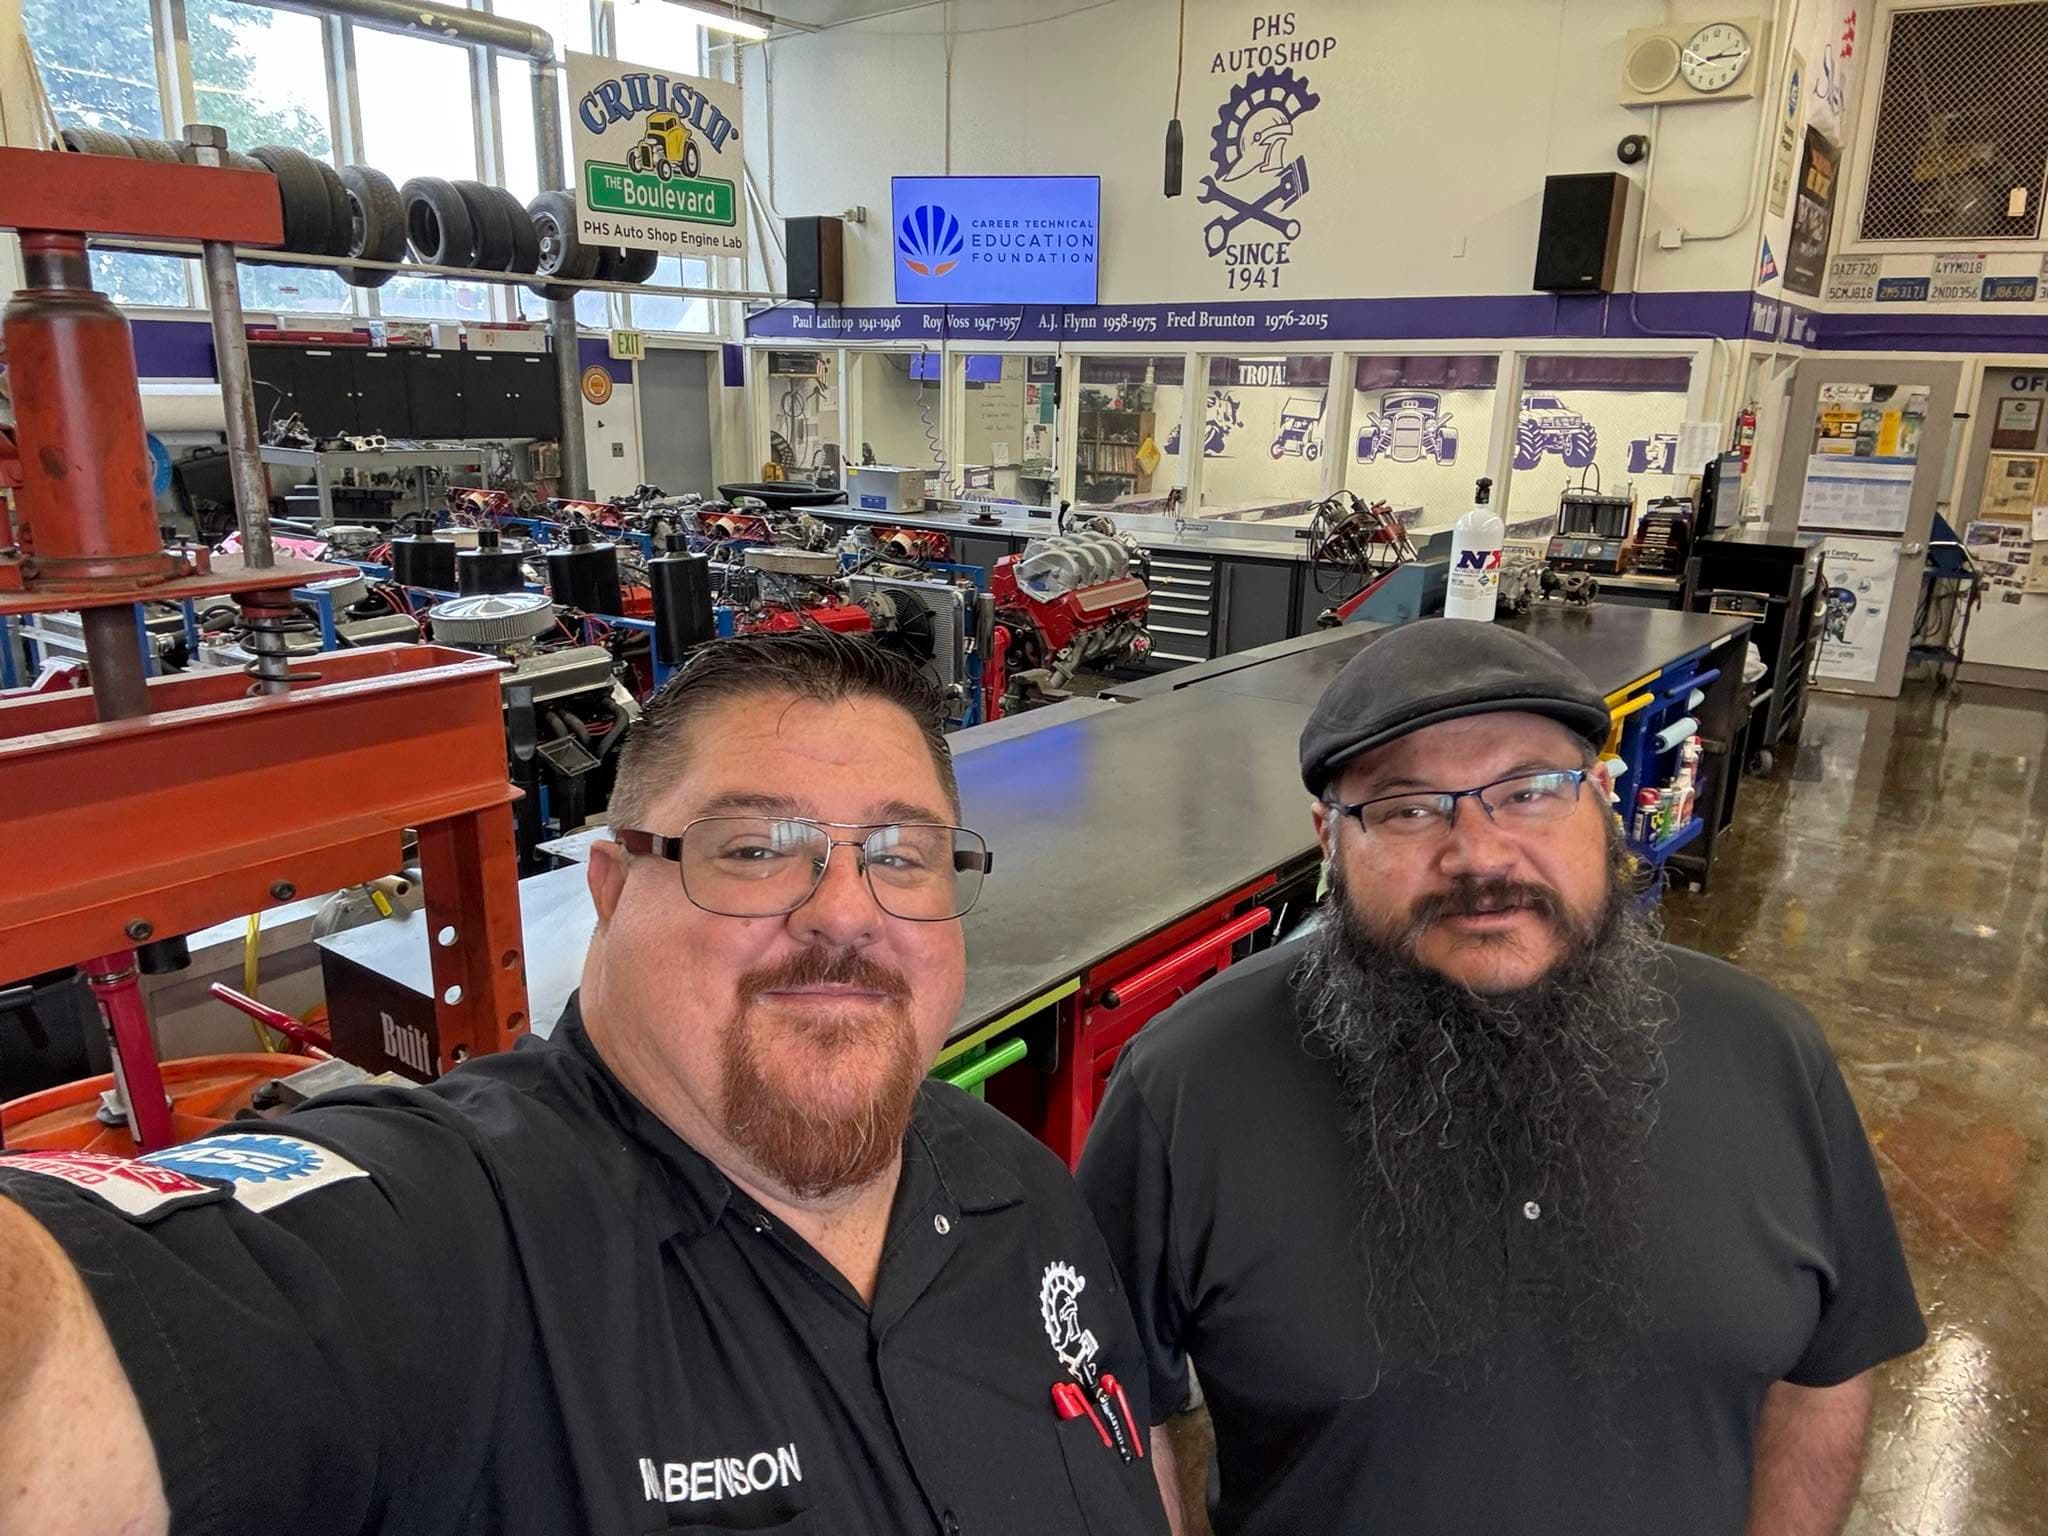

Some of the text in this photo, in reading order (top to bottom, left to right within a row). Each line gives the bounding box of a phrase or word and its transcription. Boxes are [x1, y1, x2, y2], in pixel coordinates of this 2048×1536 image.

[1252, 12, 1295, 40] PHS
[1210, 37, 1336, 73] AUTOSHOP
[604, 174, 715, 214] THE Boulevard
[584, 220, 743, 250] PHS Auto Shop Engine Lab
[972, 219, 1094, 229] CAREER TECHNICAL
[972, 234, 1094, 248] EDUCATION
[972, 253, 1094, 263] FOUNDATION
[1225, 242, 1291, 266] SINCE
[1228, 267, 1280, 291] 1941
[792, 310, 1328, 332] Paul Lathrop 1941-1946 Roy Voss 1947-1957 A.J. Flynn 1958-1975 Fred Brunton 1976-2015
[617, 333, 640, 355] EXIT
[2011, 376, 2048, 392] OF
[380, 1011, 432, 1076] Built
